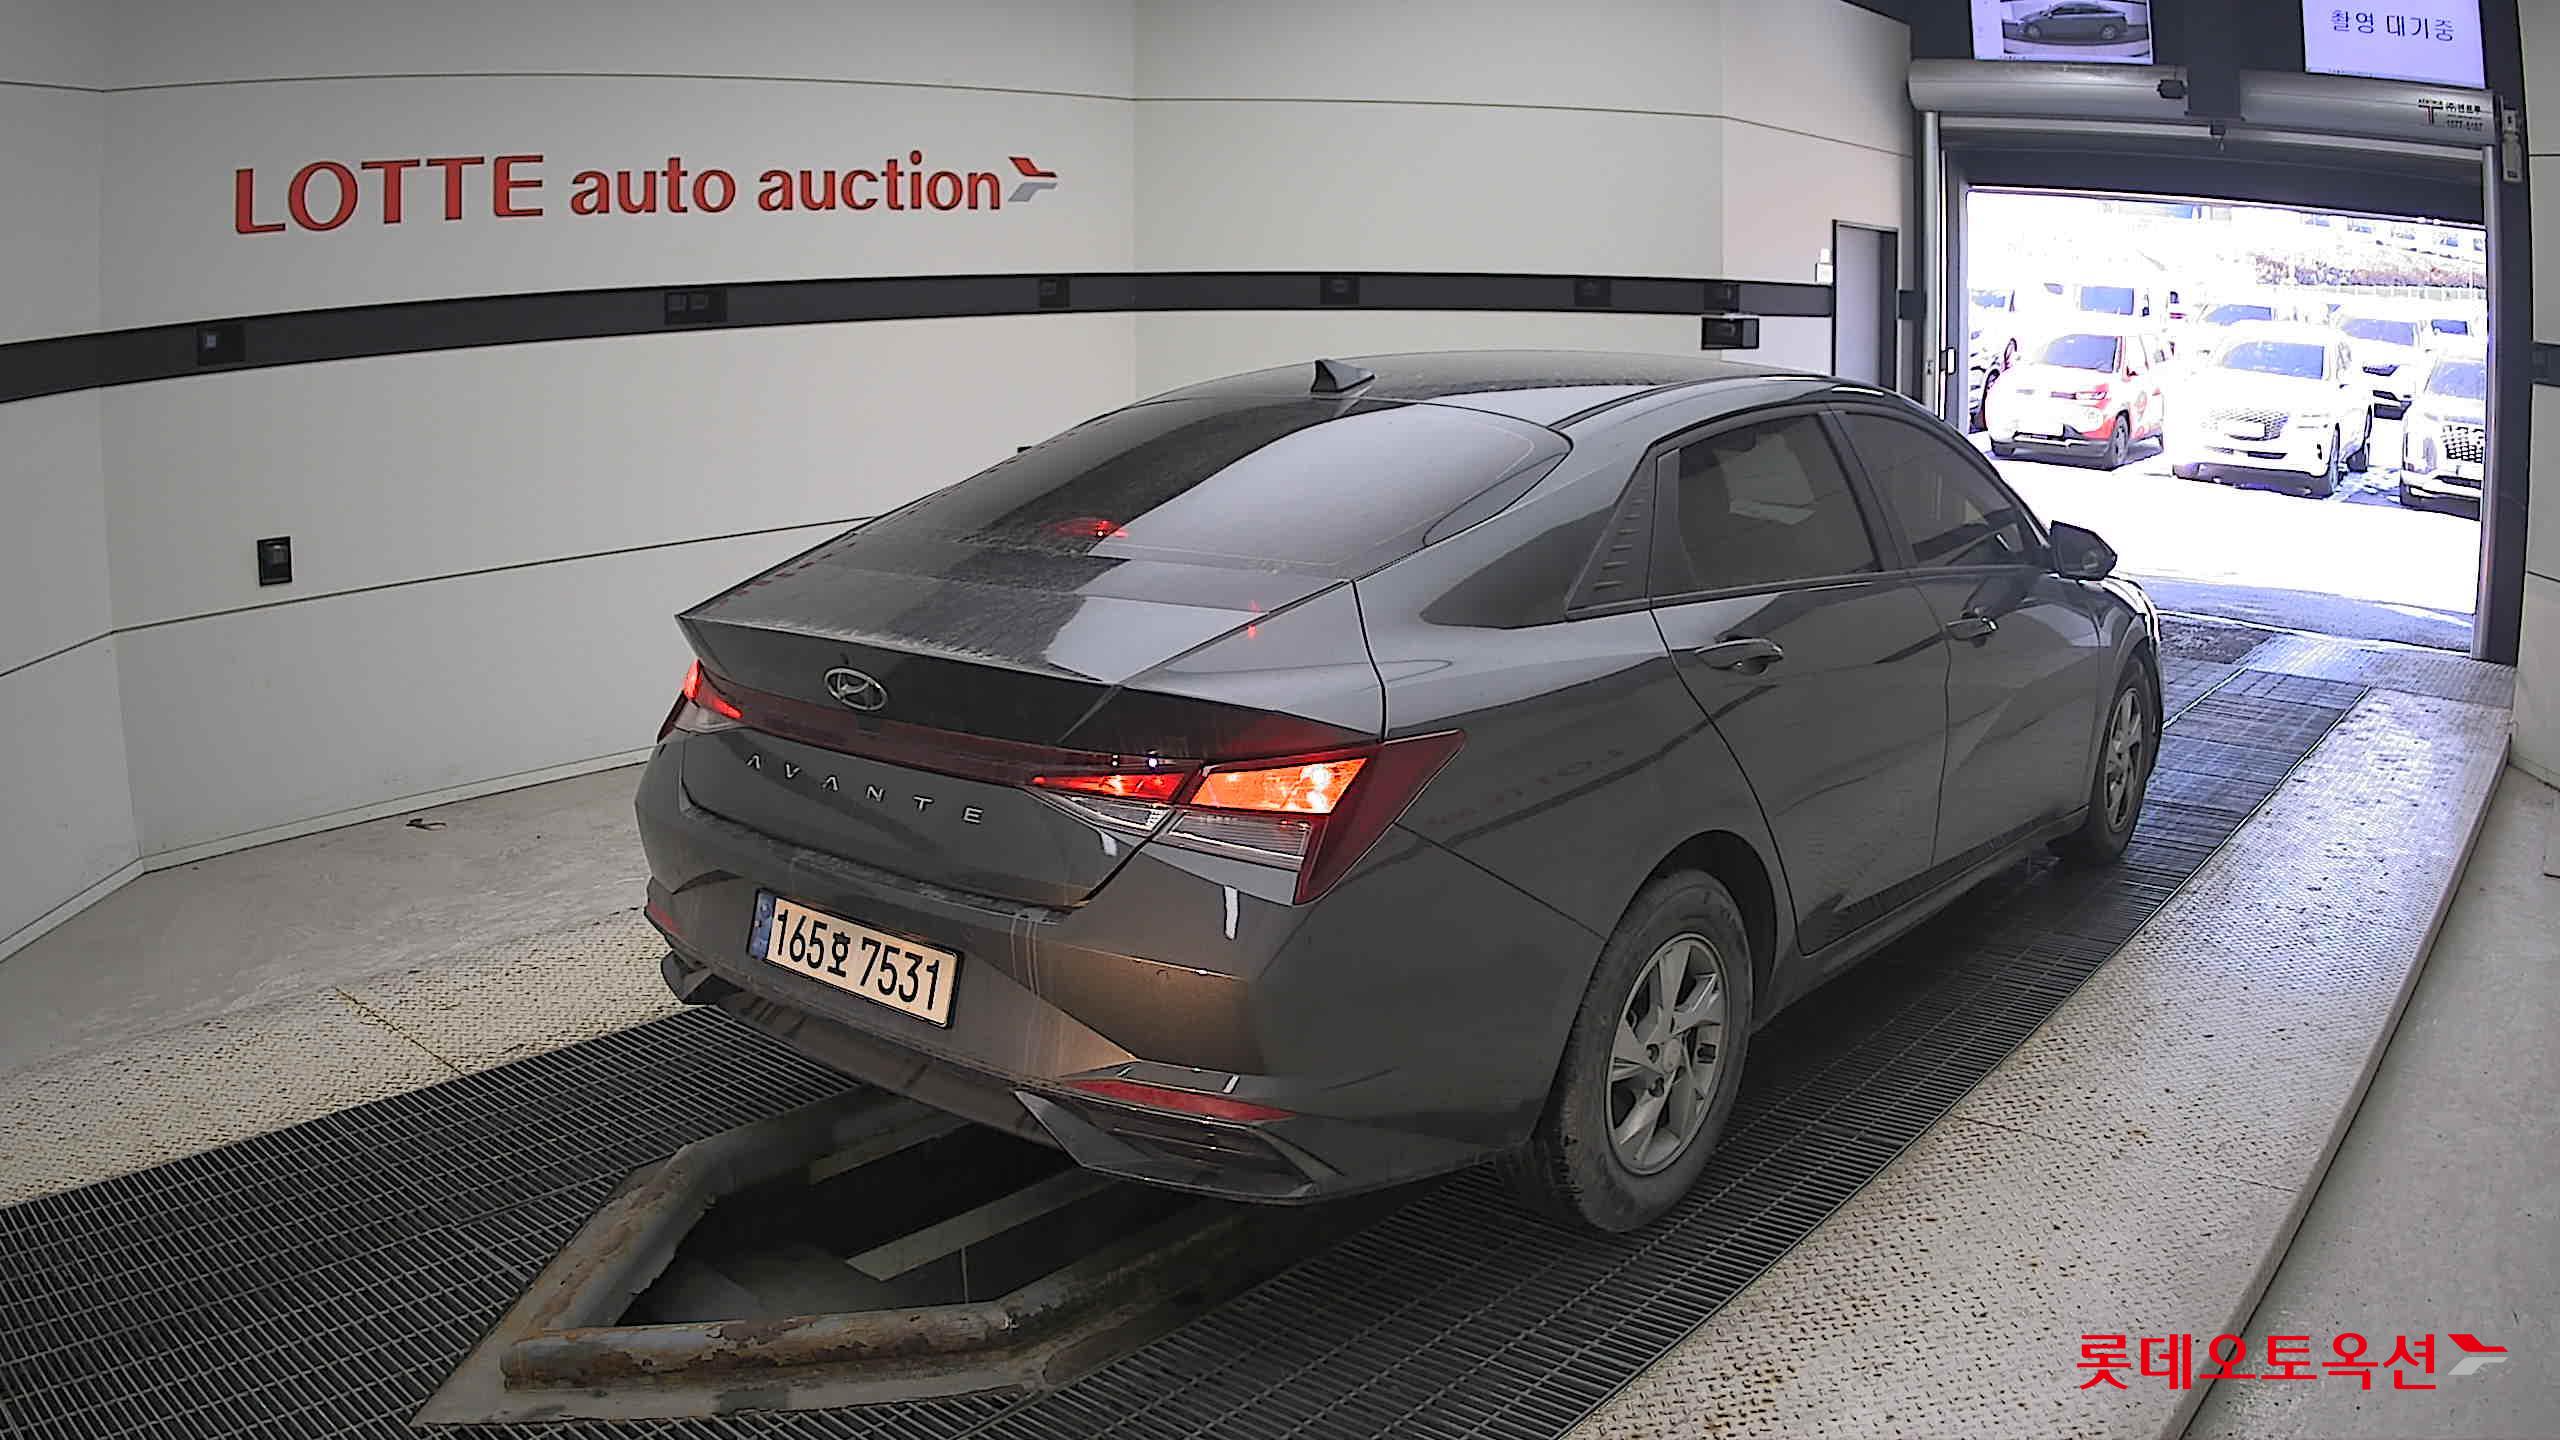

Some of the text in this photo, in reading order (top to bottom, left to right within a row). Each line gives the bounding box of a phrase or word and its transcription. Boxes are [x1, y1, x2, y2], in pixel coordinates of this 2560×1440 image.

[2331, 10, 2455, 42] 촬영 대기중
[235, 151, 1003, 234] LOTTE auto auction
[747, 754, 984, 824] AVANTE
[777, 908, 940, 1010] 165호 7531
